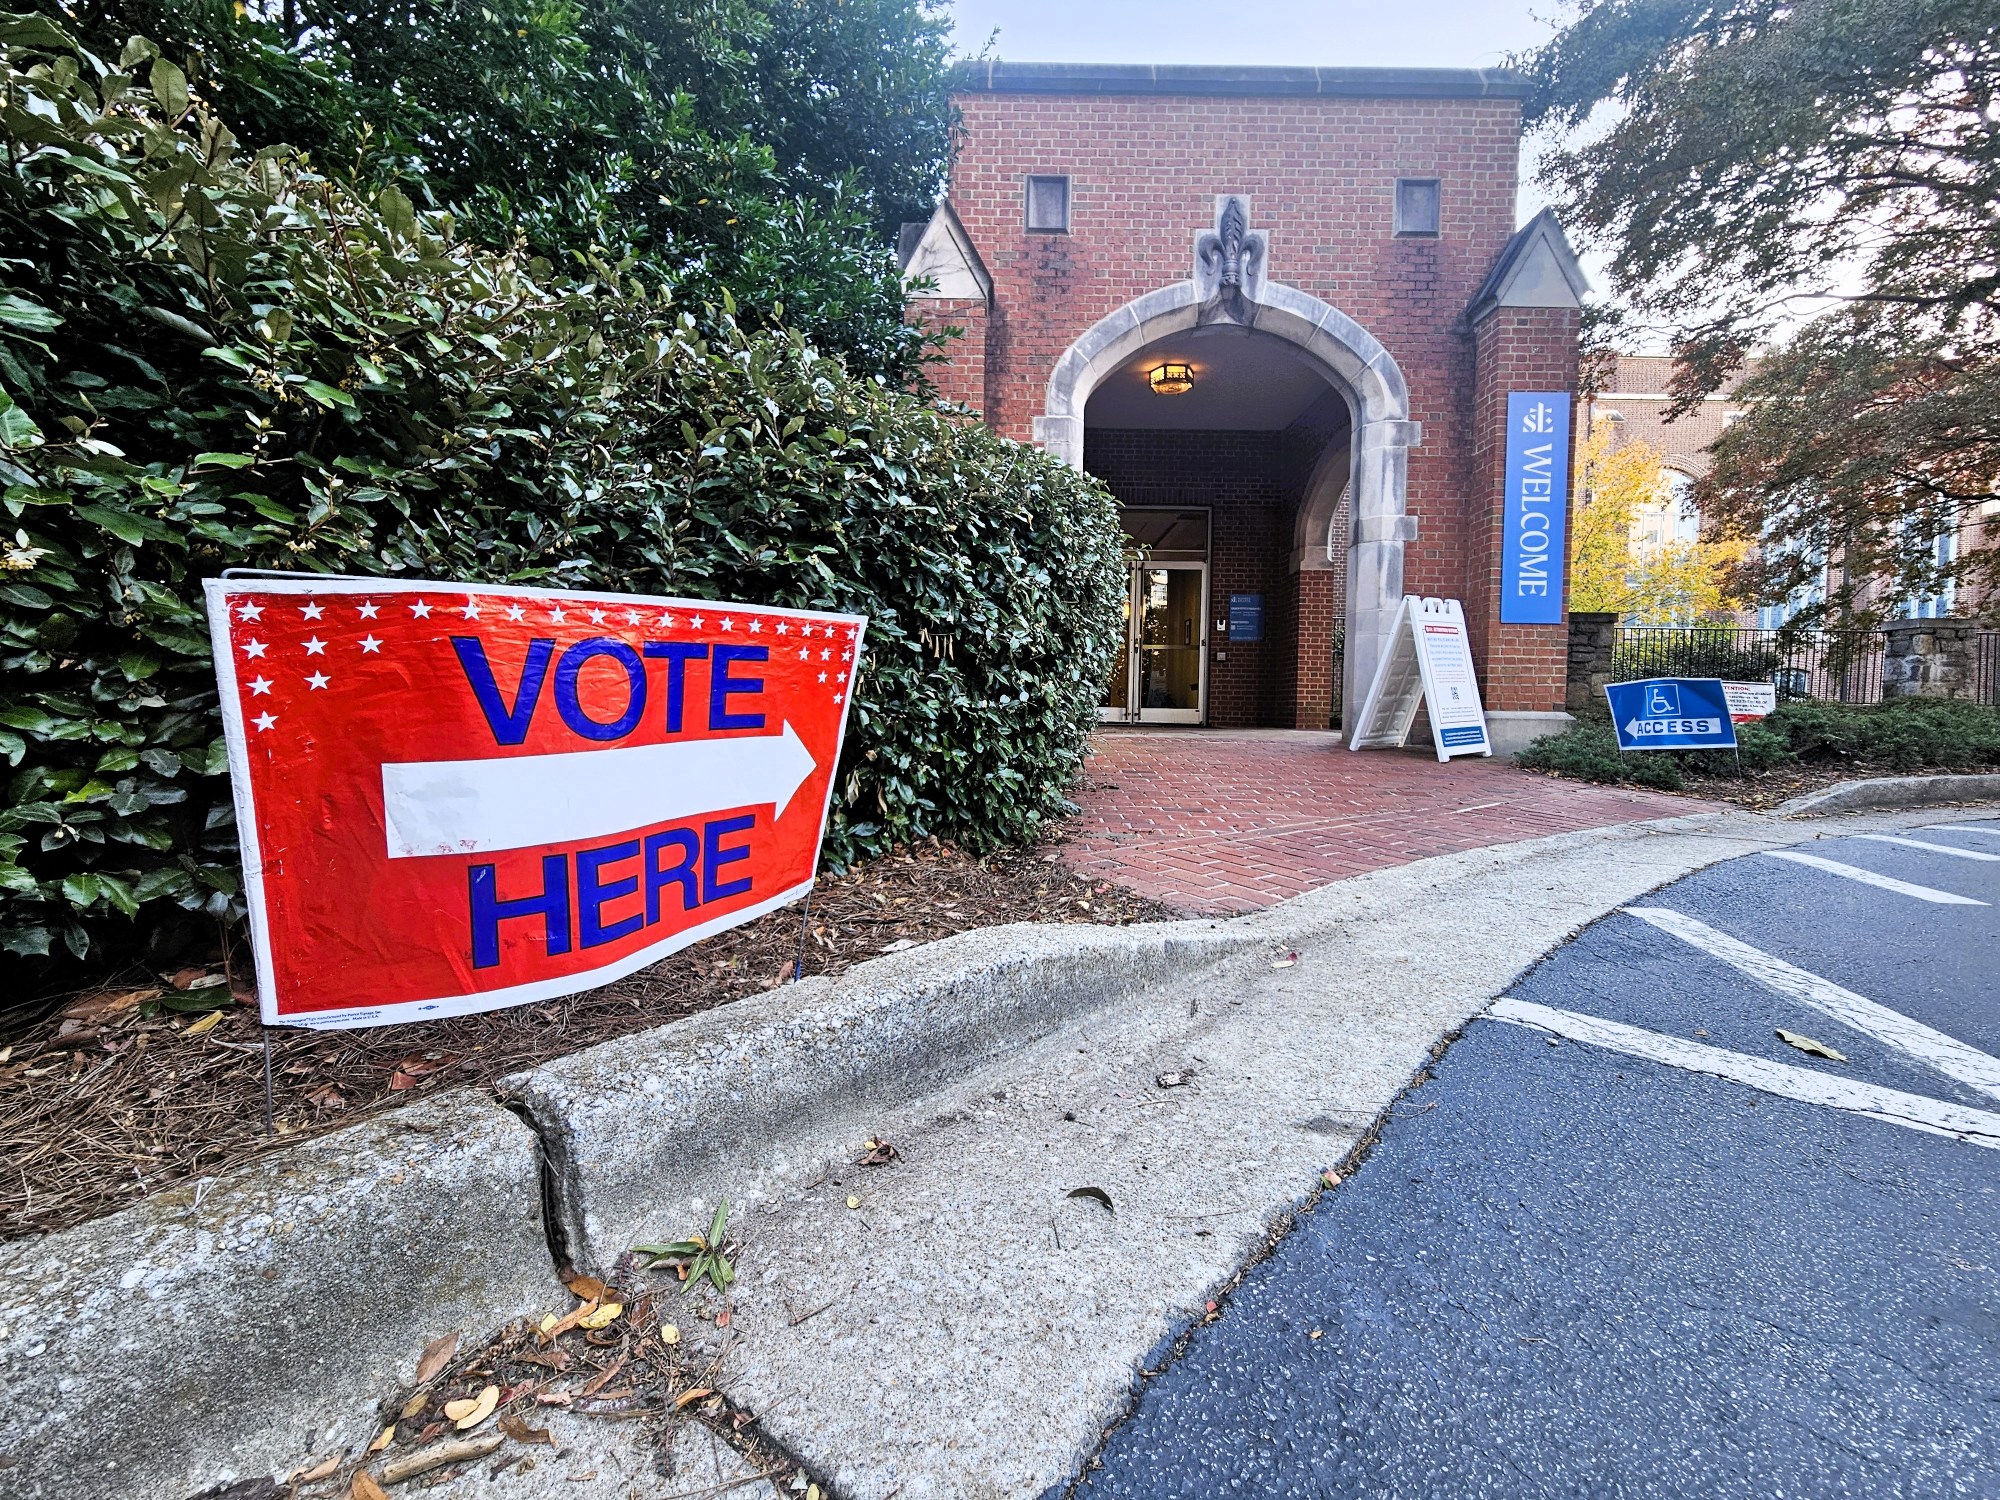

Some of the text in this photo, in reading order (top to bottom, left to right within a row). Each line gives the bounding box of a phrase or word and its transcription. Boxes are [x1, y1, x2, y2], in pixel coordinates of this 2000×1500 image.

[1518, 443, 1553, 597] WELCOME
[450, 635, 770, 746] VOTE
[1636, 720, 1710, 734] ACCESS
[467, 815, 756, 970] HERE
